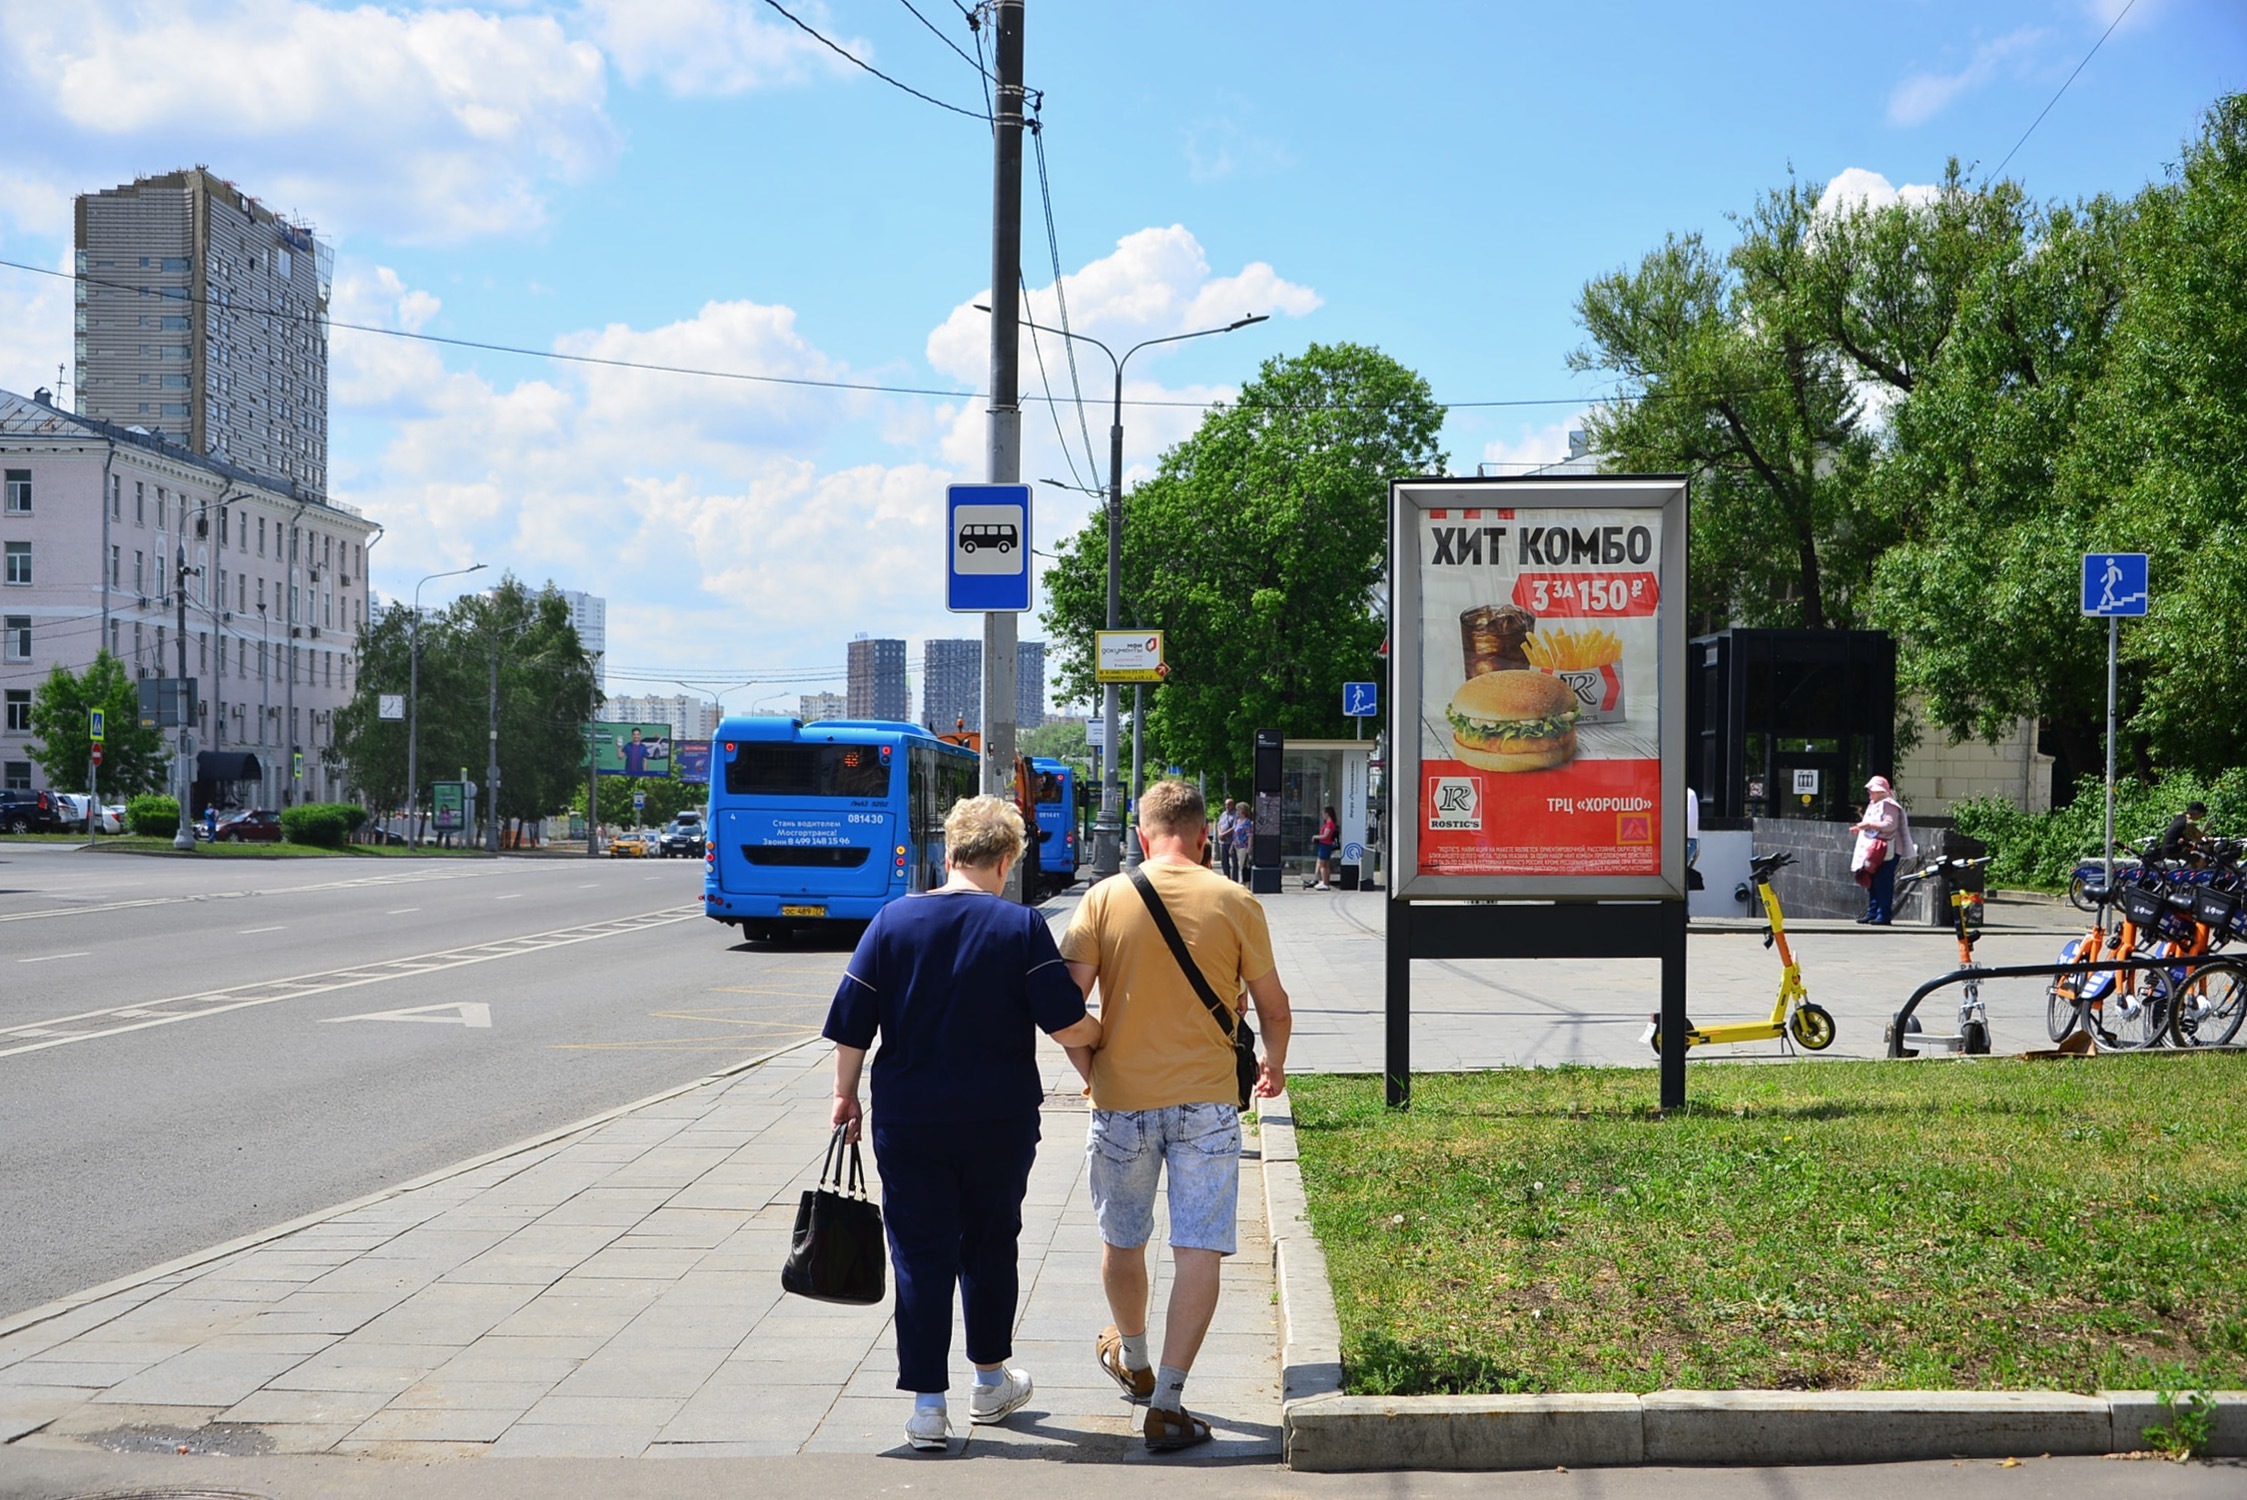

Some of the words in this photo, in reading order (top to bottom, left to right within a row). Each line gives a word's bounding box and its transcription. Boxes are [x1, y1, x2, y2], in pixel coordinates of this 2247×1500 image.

[1431, 527, 1506, 565] ХИТ
[1519, 525, 1652, 565] КОМБО
[1547, 798, 1574, 814] ТРЦ
[1577, 797, 1652, 812] «ХОРОШО»
[848, 814, 884, 824] 081430
